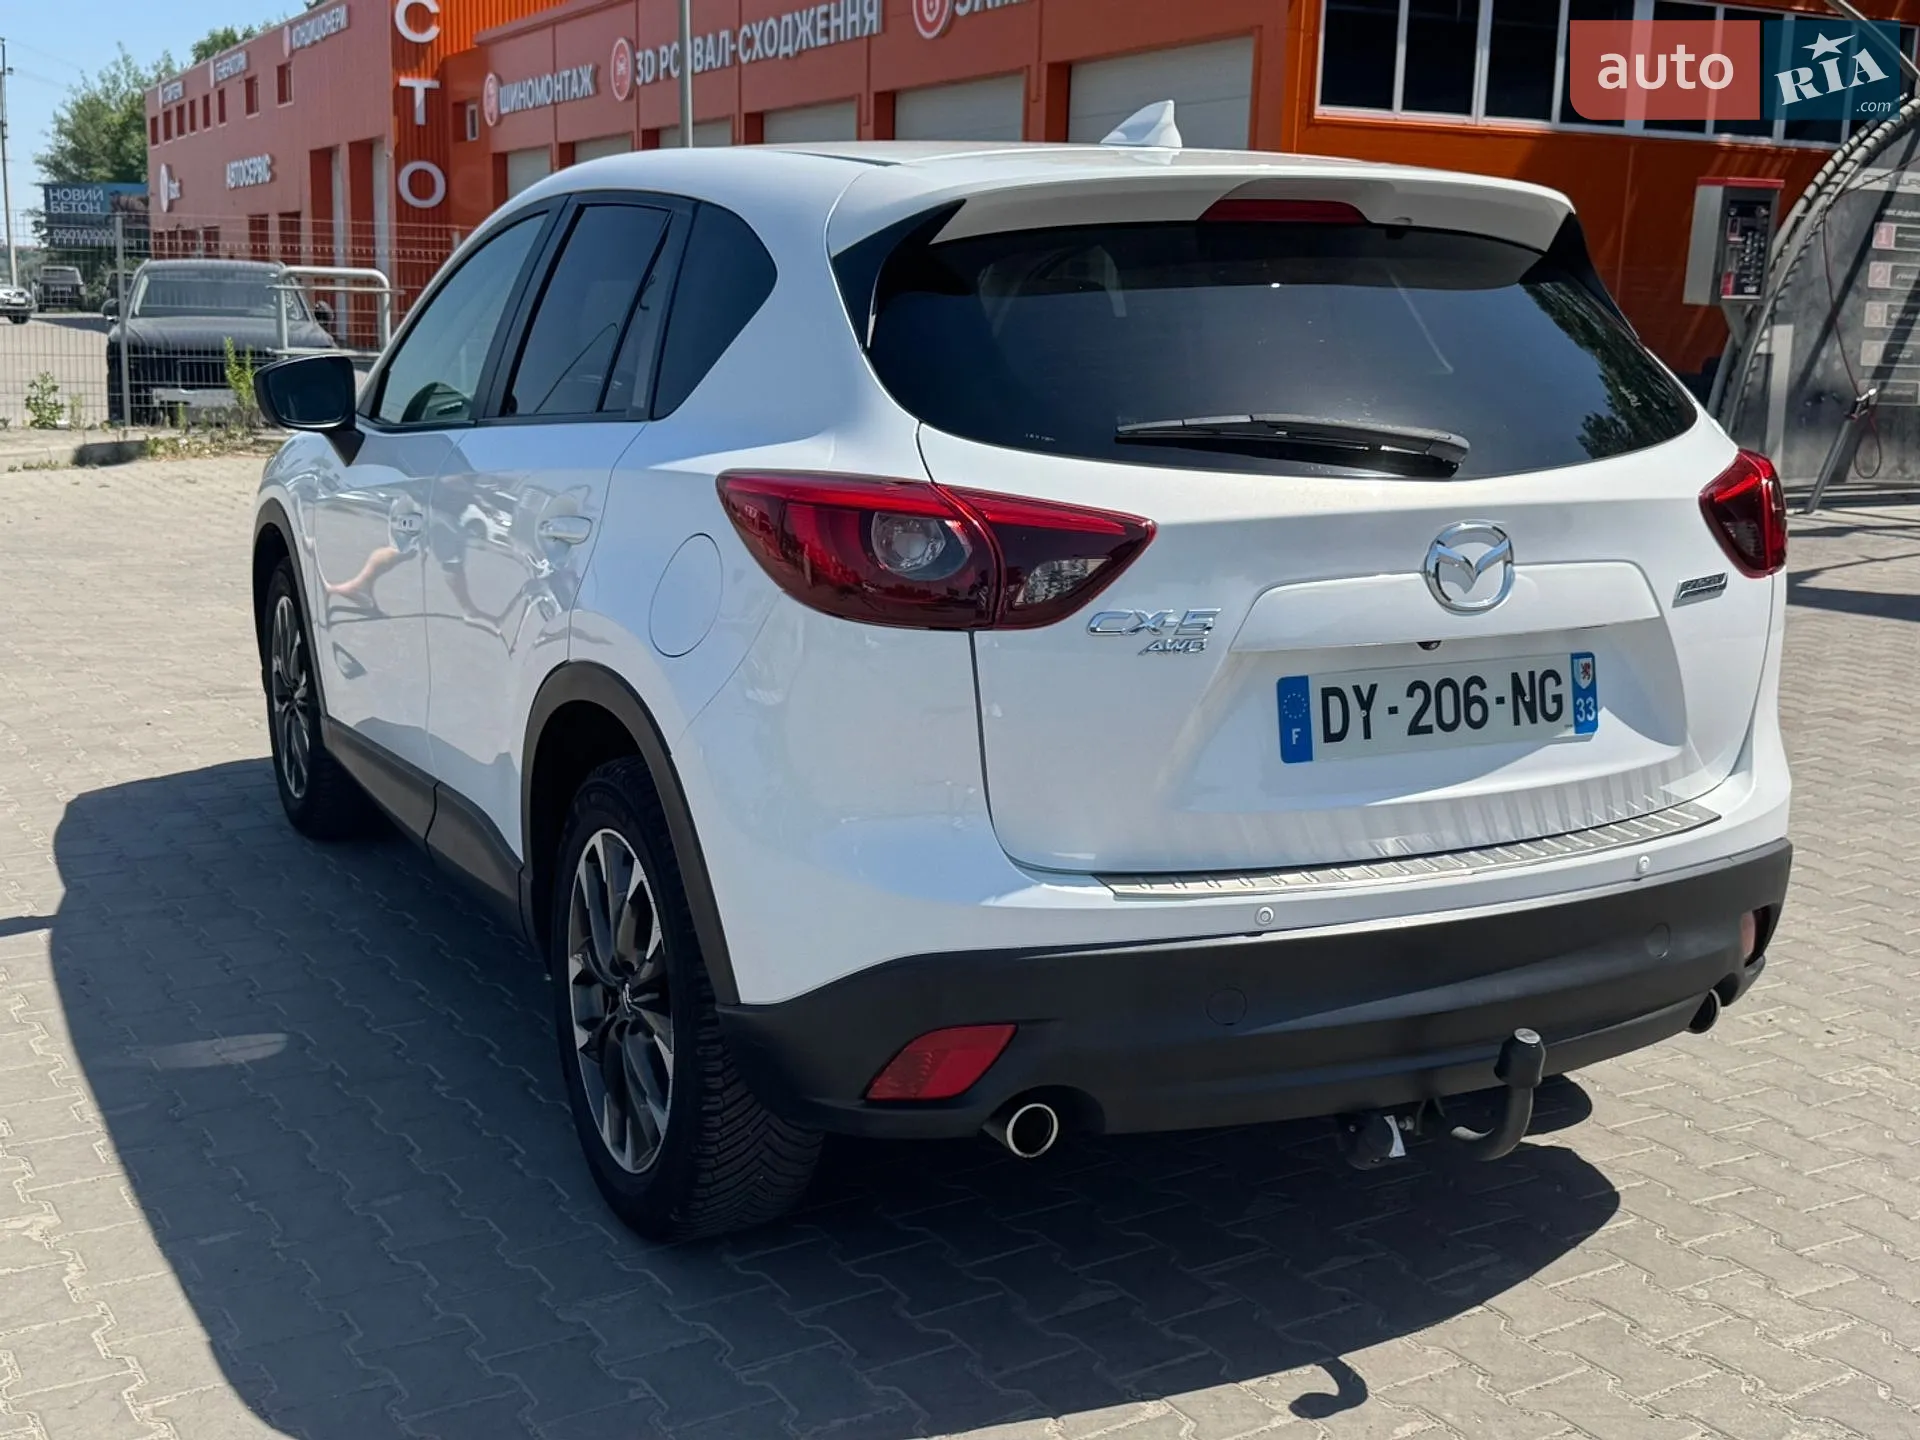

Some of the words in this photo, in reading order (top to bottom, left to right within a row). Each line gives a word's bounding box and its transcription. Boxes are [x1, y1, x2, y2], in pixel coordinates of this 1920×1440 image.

[635, 49, 655, 86] 3D
[659, 0, 882, 80] РОВАЛ-СХОДЖЕННЯ
[499, 64, 595, 114] ШИНОМОНТАЖ
[49, 186, 104, 201] НОВИЙ
[50, 201, 102, 213] БЕТОН
[1875, 267, 1885, 282] 2
[1086, 607, 1221, 636] CX-5
[1138, 638, 1208, 656] AWD
[1291, 728, 1301, 745] F
[1320, 668, 1564, 743] DY-206-NG
[1576, 696, 1596, 722] 33
